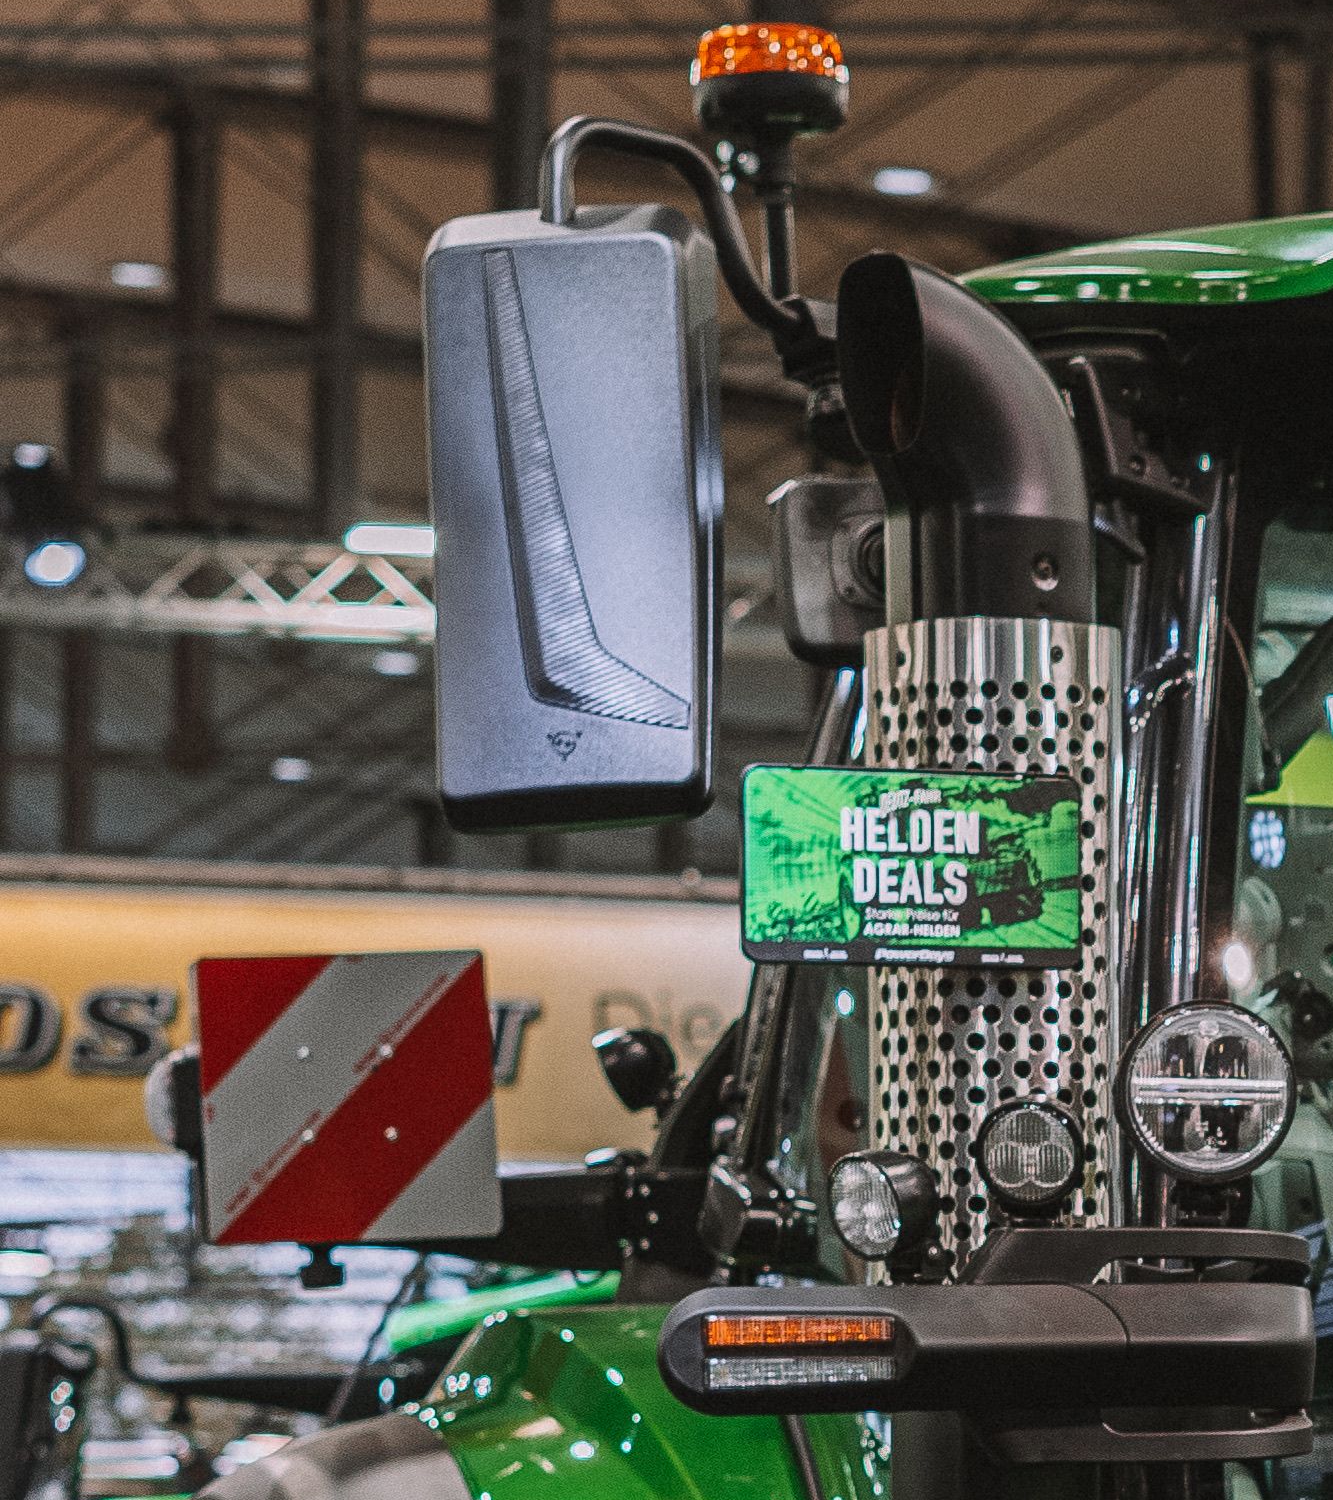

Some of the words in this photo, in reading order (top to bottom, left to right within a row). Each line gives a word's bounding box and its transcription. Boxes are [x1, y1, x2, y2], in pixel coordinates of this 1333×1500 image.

[840, 806, 980, 855] HELDEN
[853, 859, 968, 906] DEALS
[863, 922, 961, 938] AGRAR-HELDEN
